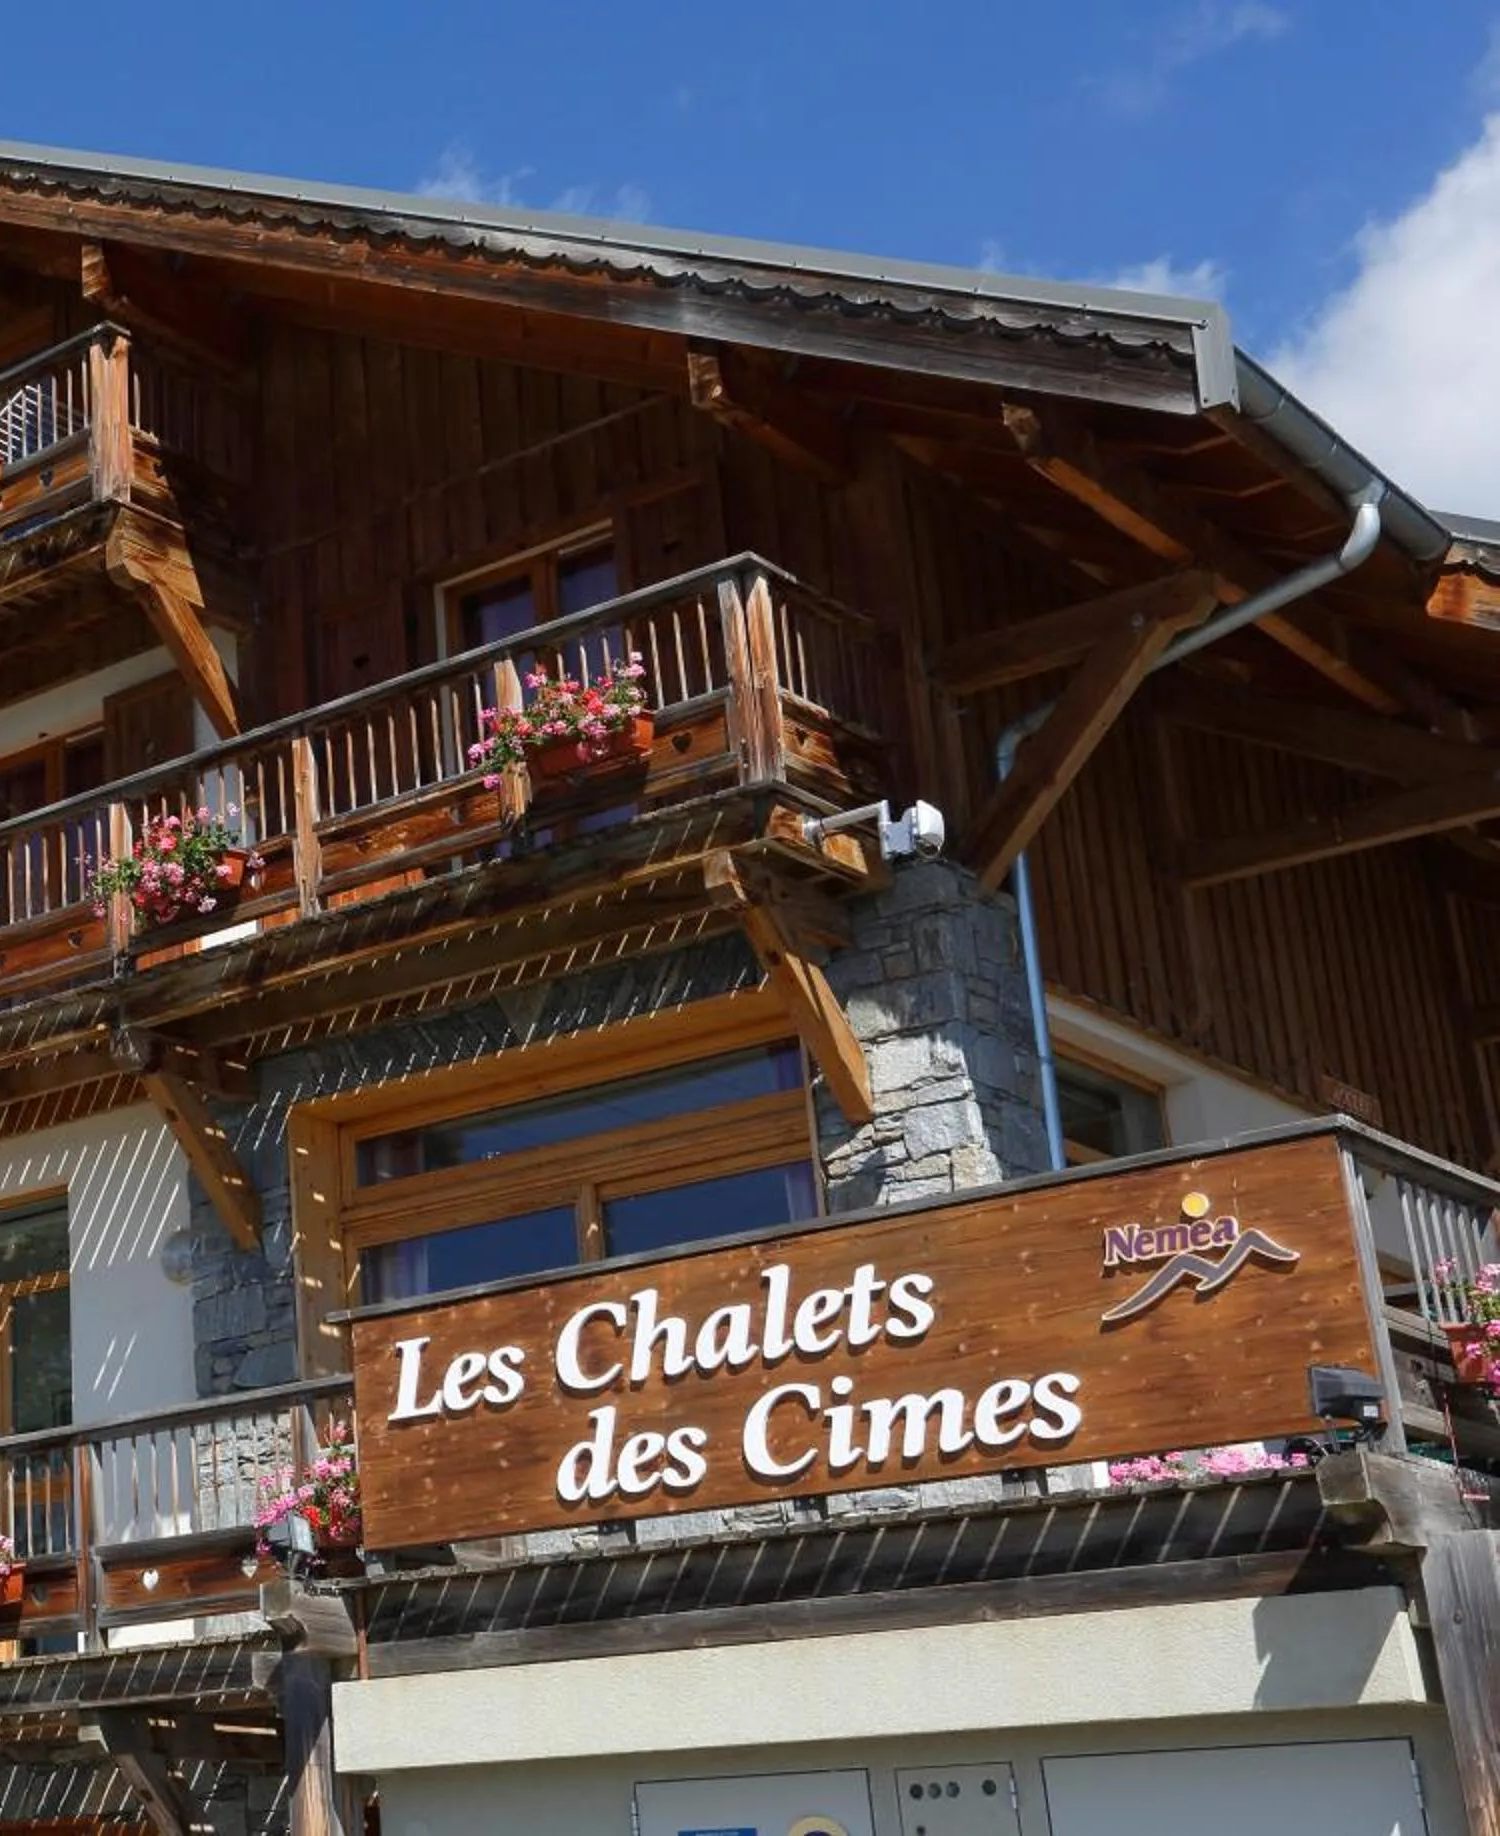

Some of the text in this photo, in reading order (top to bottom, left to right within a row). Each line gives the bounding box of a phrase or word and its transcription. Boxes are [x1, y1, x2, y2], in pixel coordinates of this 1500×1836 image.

[387, 1263, 936, 1422] Les Chalets
[556, 1372, 1083, 1502] des Cimes
